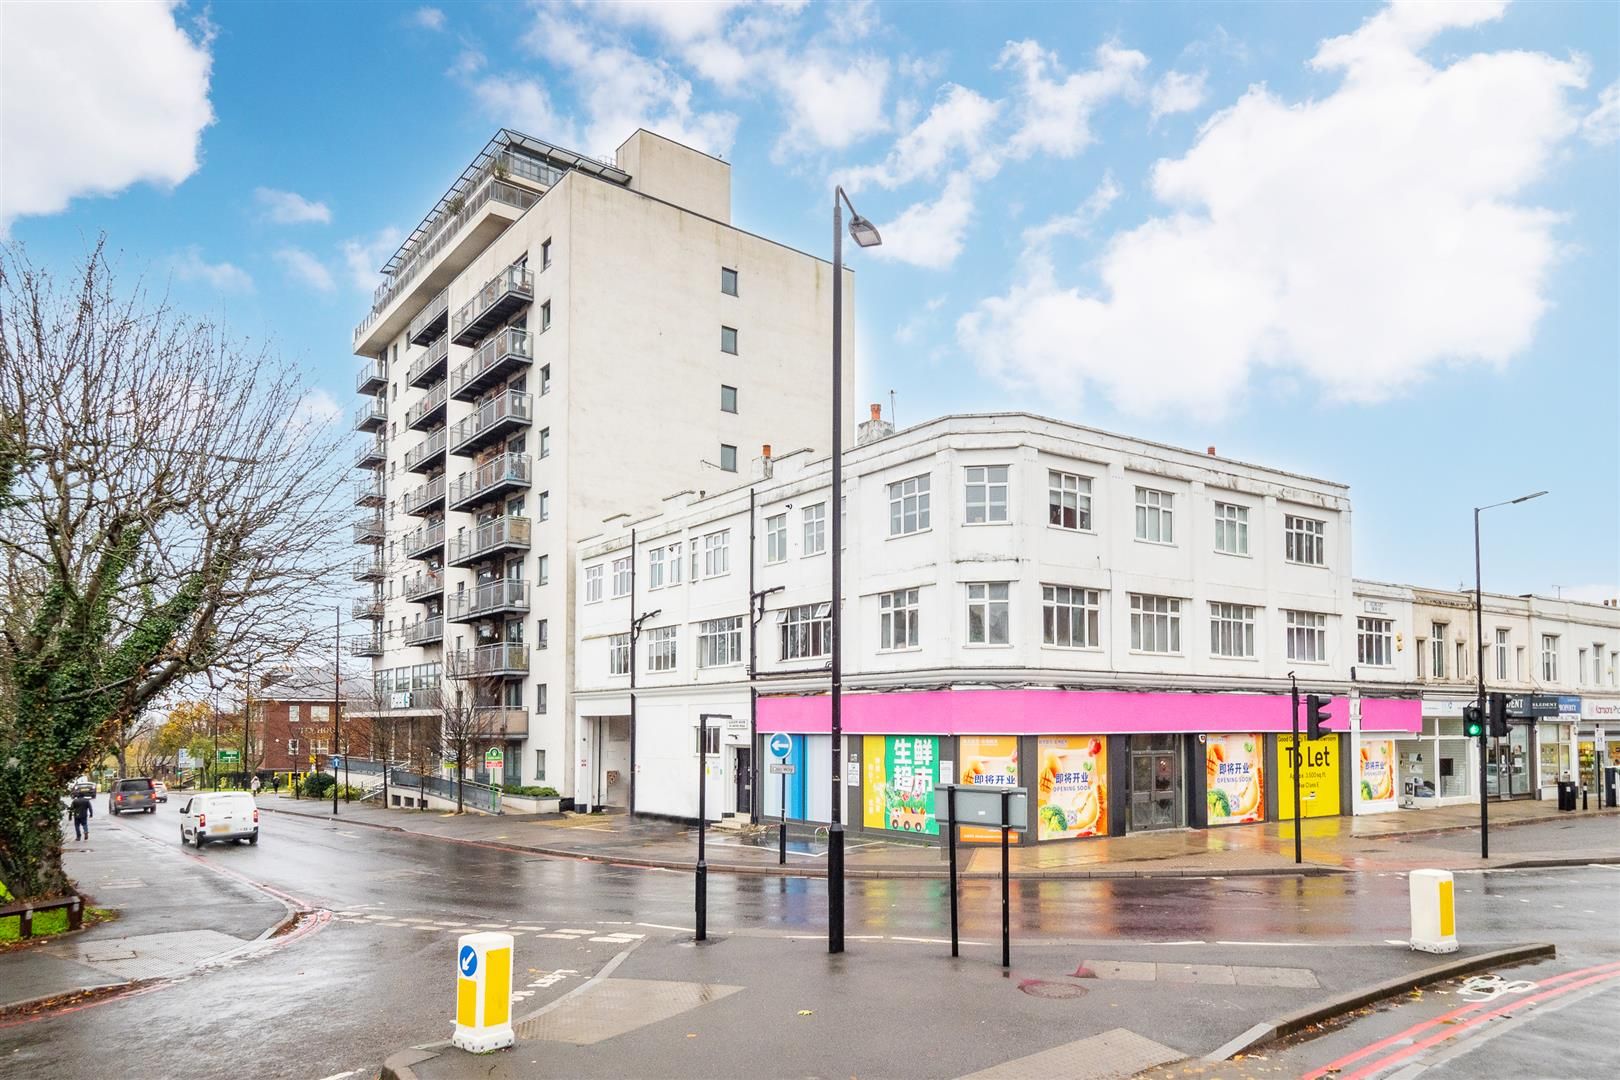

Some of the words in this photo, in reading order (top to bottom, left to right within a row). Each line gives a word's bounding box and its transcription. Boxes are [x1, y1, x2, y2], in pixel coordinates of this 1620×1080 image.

[893, 738, 933, 766] 生鲜
[1307, 745, 1330, 768] Let
[1219, 762, 1249, 775] 即将开业
[893, 765, 933, 799] 超市
[974, 774, 1016, 785] 即将开业
[1055, 771, 1089, 784] 即将开业
[1053, 785, 1076, 793] OPENING
[1076, 784, 1091, 792] SOON
